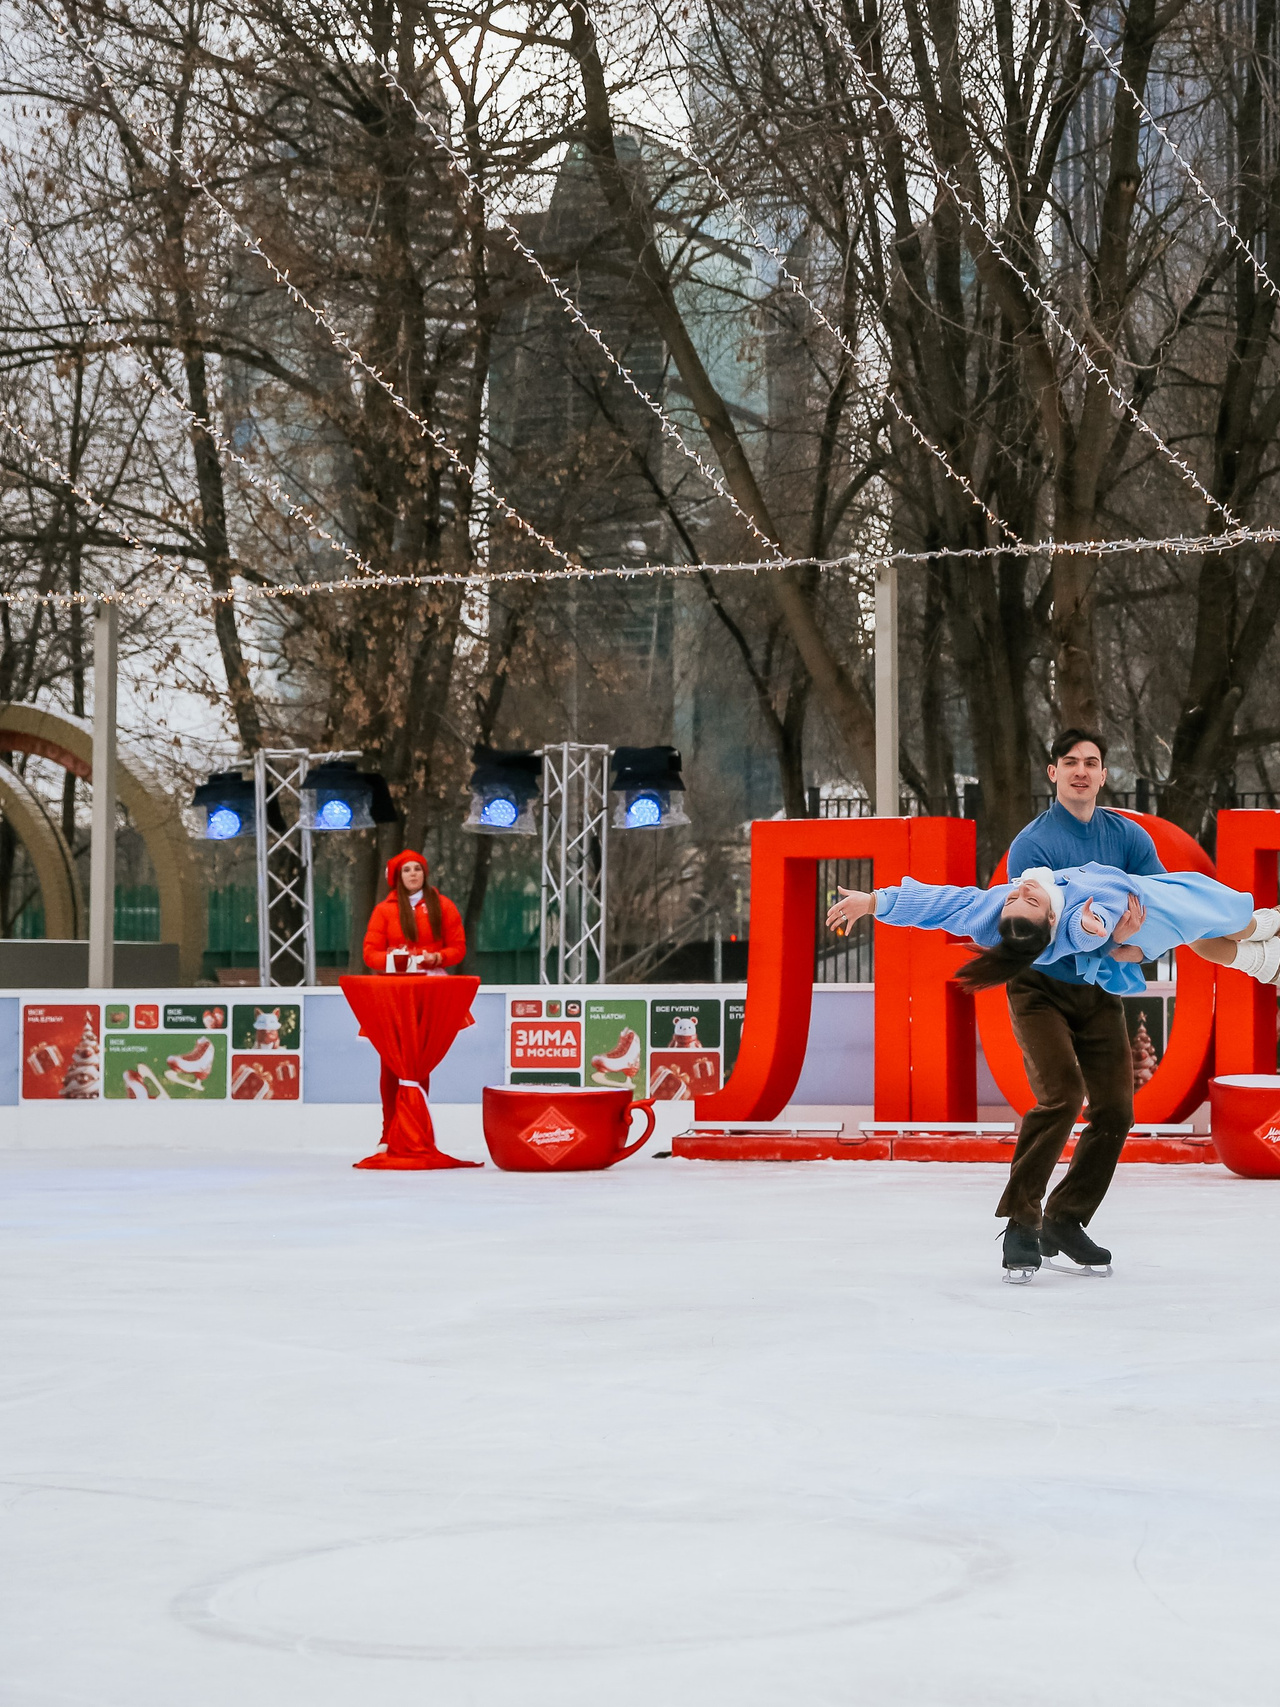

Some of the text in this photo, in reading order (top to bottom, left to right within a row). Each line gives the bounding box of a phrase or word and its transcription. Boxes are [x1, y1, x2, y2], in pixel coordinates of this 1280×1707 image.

[515, 1030, 577, 1046] ЗИМА
[515, 1048, 577, 1058] В МОСКВЕ
